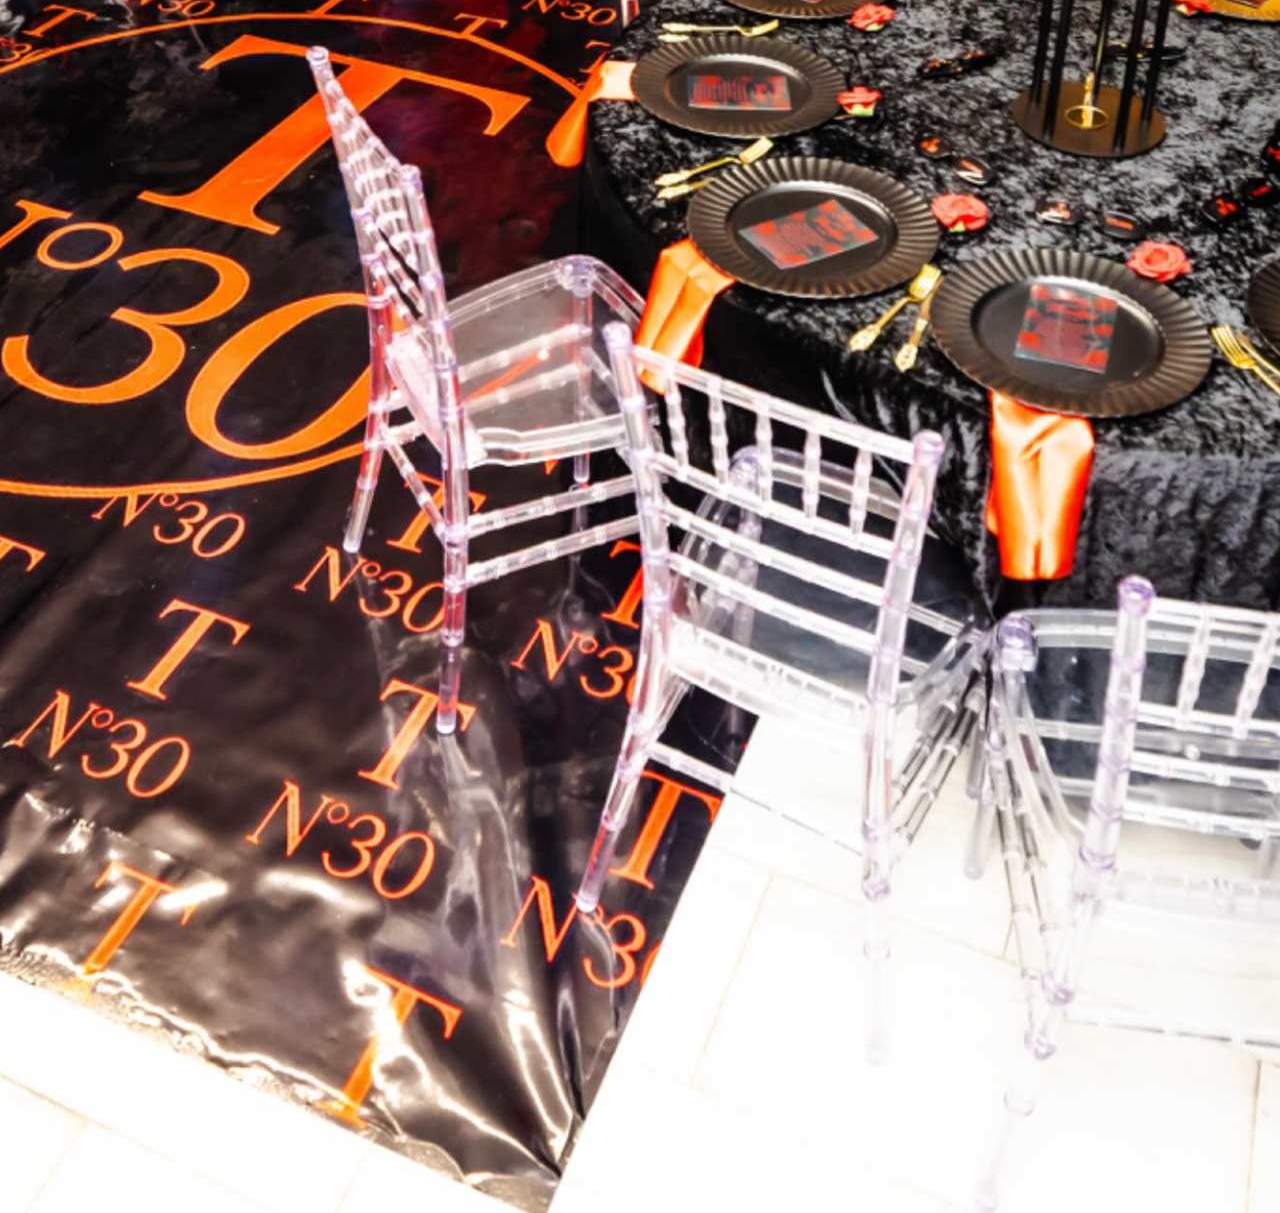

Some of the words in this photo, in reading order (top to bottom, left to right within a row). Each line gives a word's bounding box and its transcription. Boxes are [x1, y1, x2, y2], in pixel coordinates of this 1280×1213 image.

[23, 3, 96, 37] T
[454, 12, 508, 36] T
[139, 35, 529, 235] T
[129, 599, 249, 700] T
[512, 620, 637, 706] N°3
[360, 679, 475, 791] T
[606, 770, 726, 890] T
[77, 860, 198, 984] T
